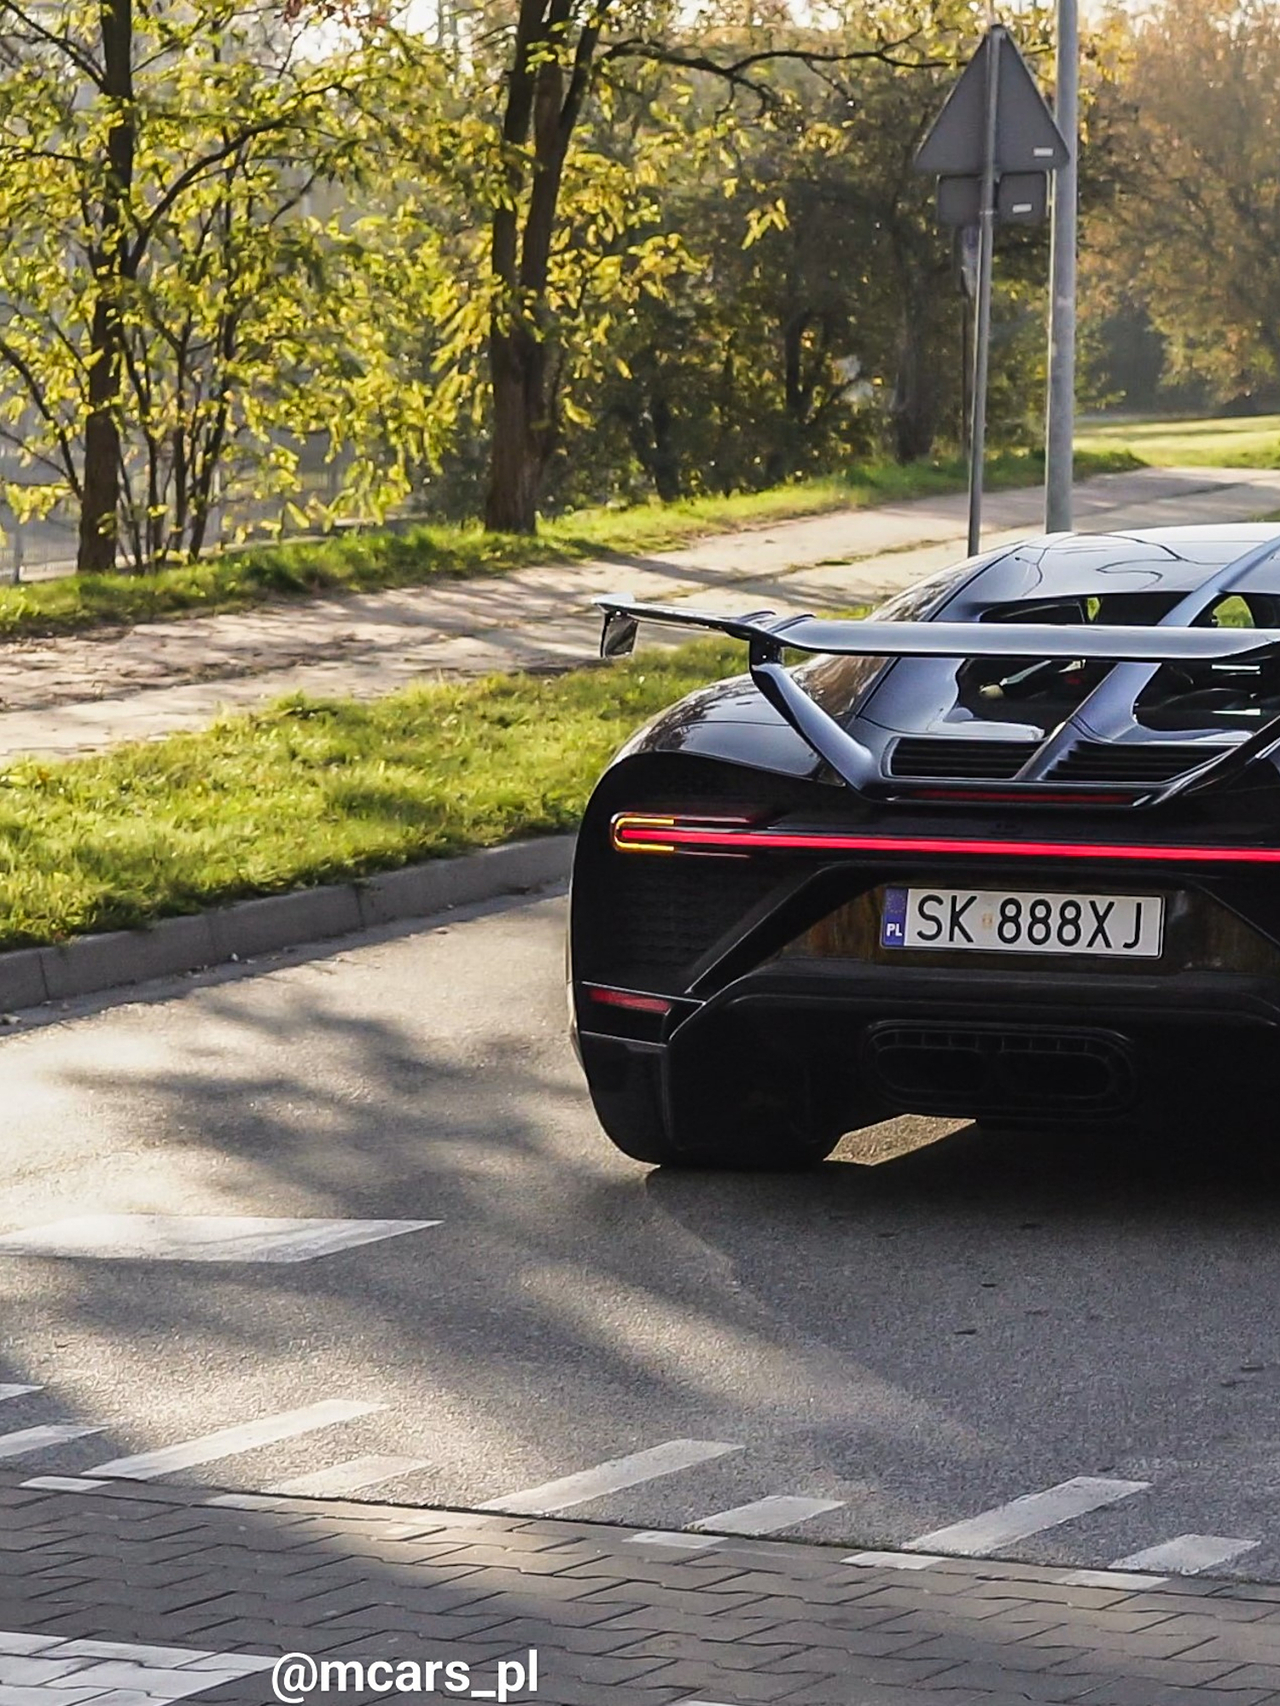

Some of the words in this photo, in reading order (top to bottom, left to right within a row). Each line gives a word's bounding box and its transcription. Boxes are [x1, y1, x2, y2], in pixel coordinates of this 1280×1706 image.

[886, 923, 903, 937] PL
[916, 894, 978, 943] SK
[997, 897, 1143, 950] 888XJ
